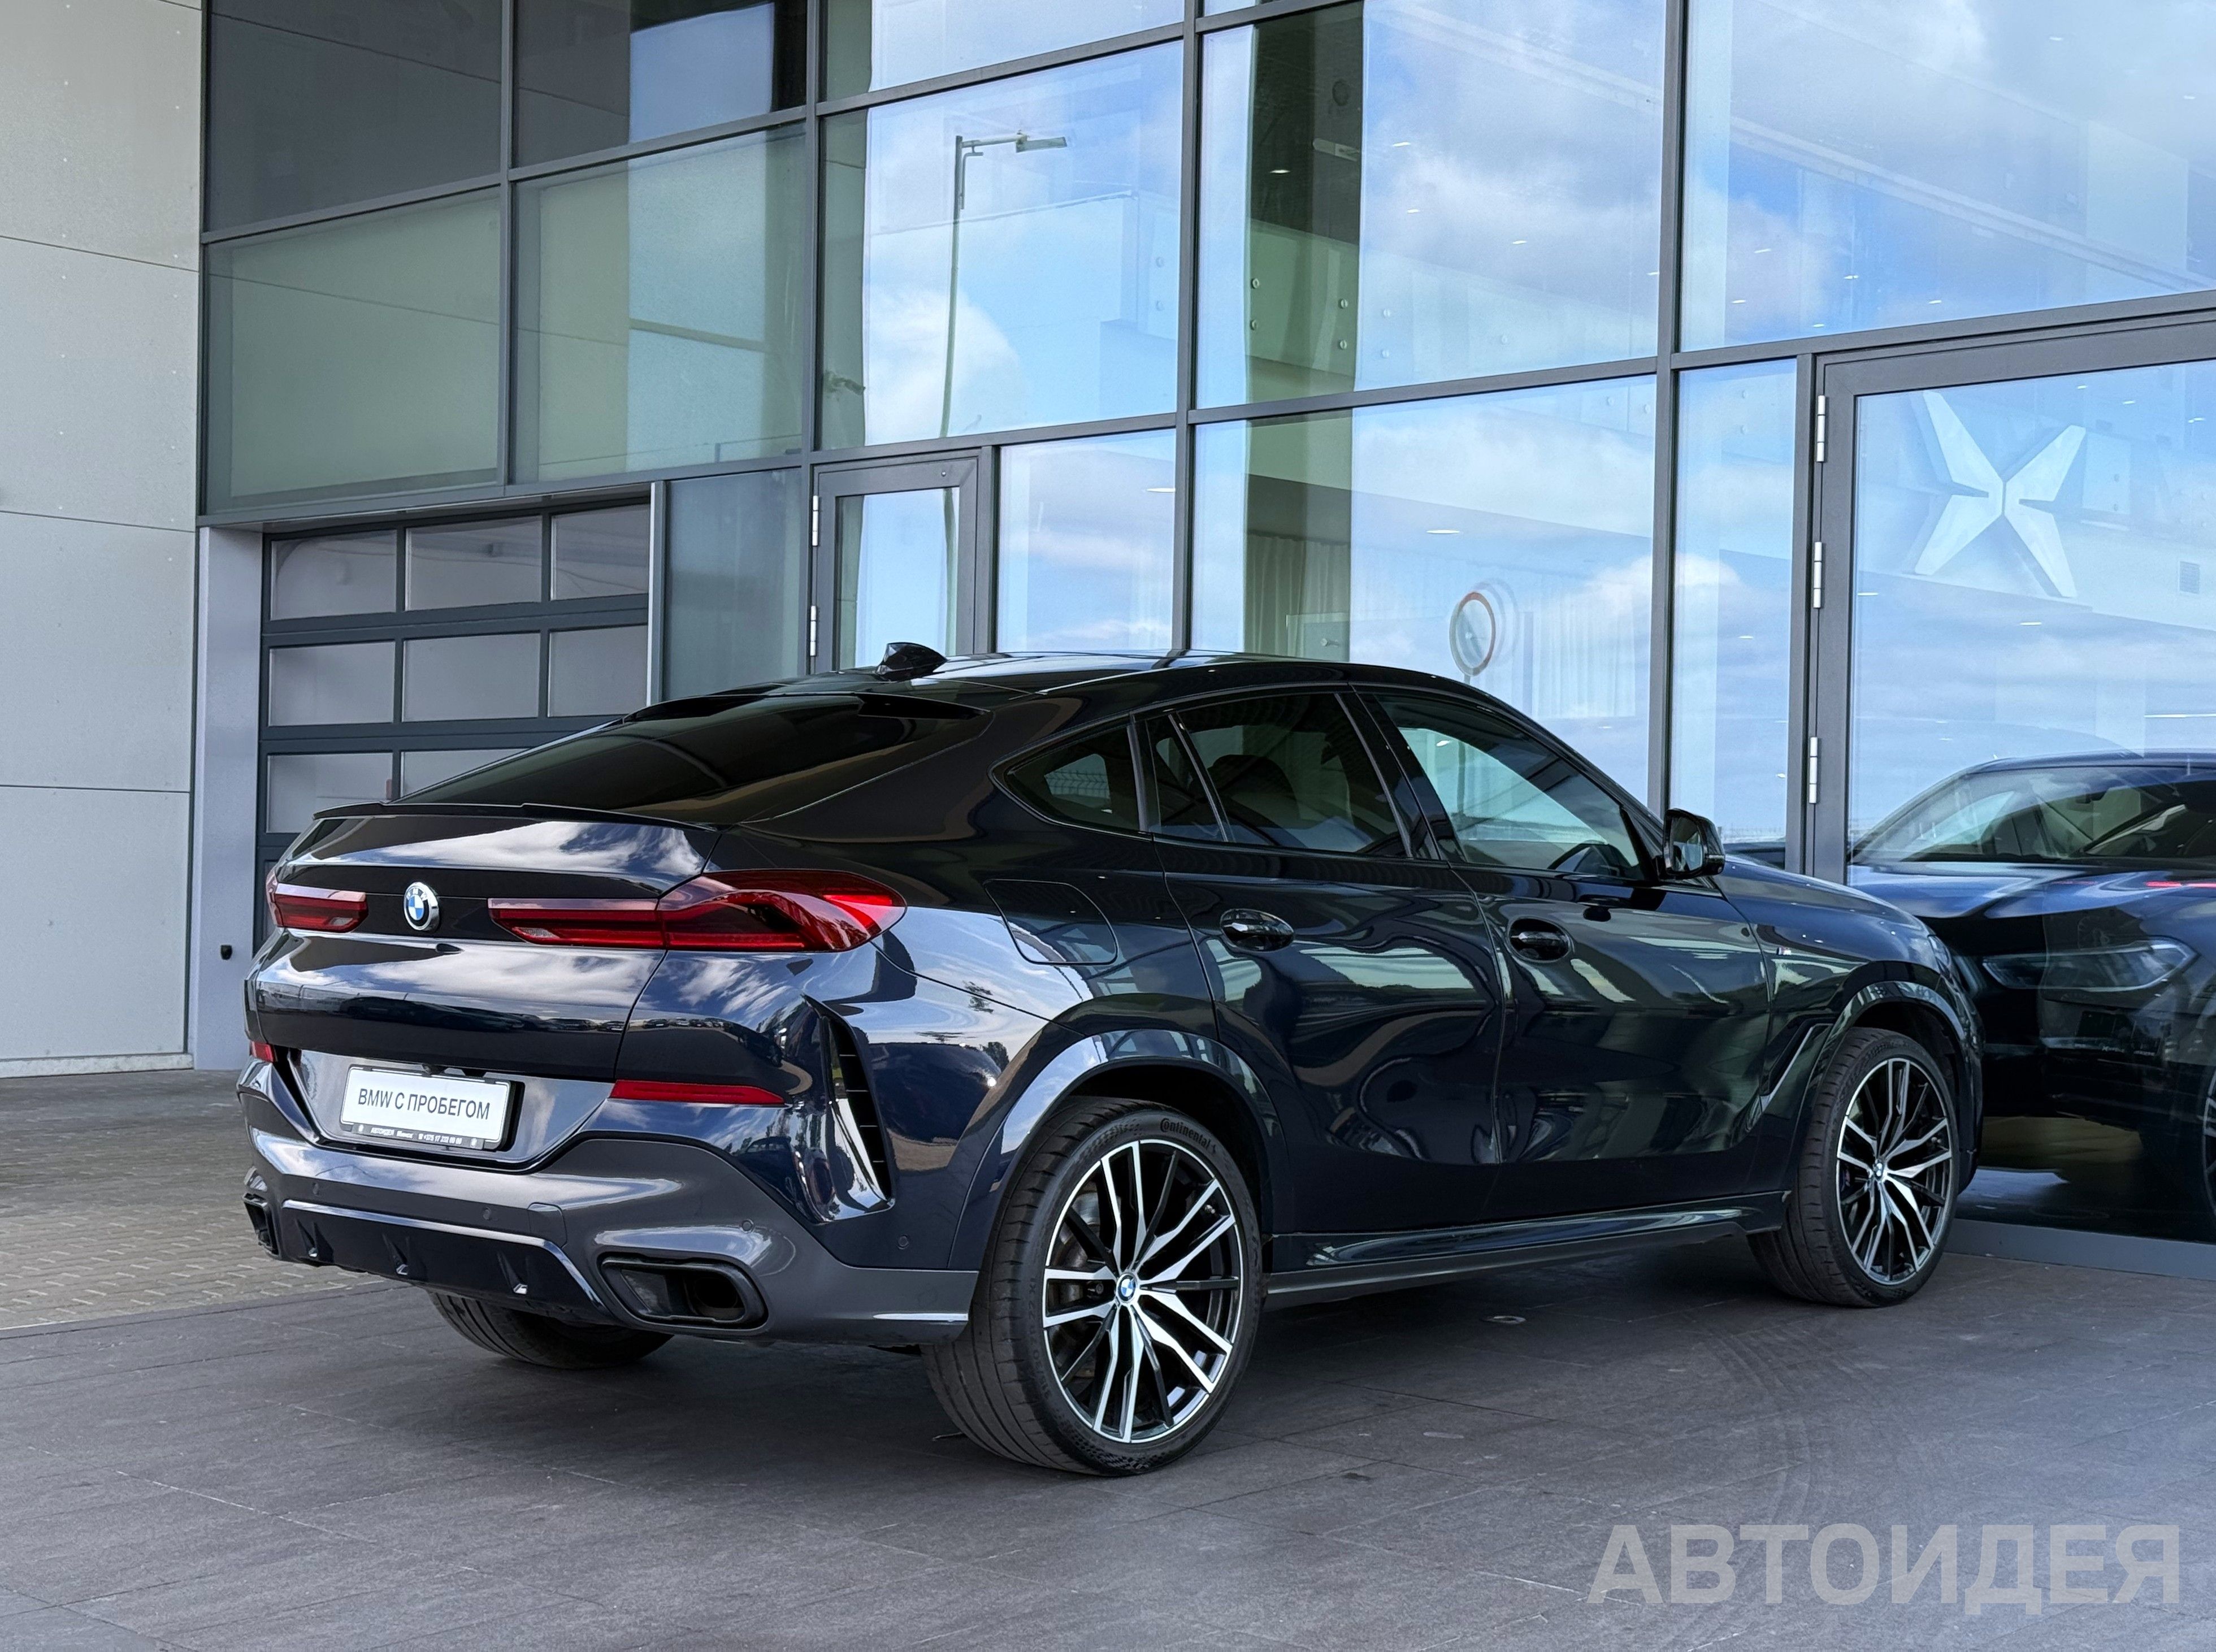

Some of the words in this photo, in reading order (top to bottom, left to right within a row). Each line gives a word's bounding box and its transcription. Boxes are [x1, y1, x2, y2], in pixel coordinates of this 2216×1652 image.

[358, 1088, 393, 1108] BMW
[395, 1092, 405, 1109] С
[407, 1094, 490, 1120] ПРОБЕГОМ
[1160, 1118, 1211, 1150] Continental
